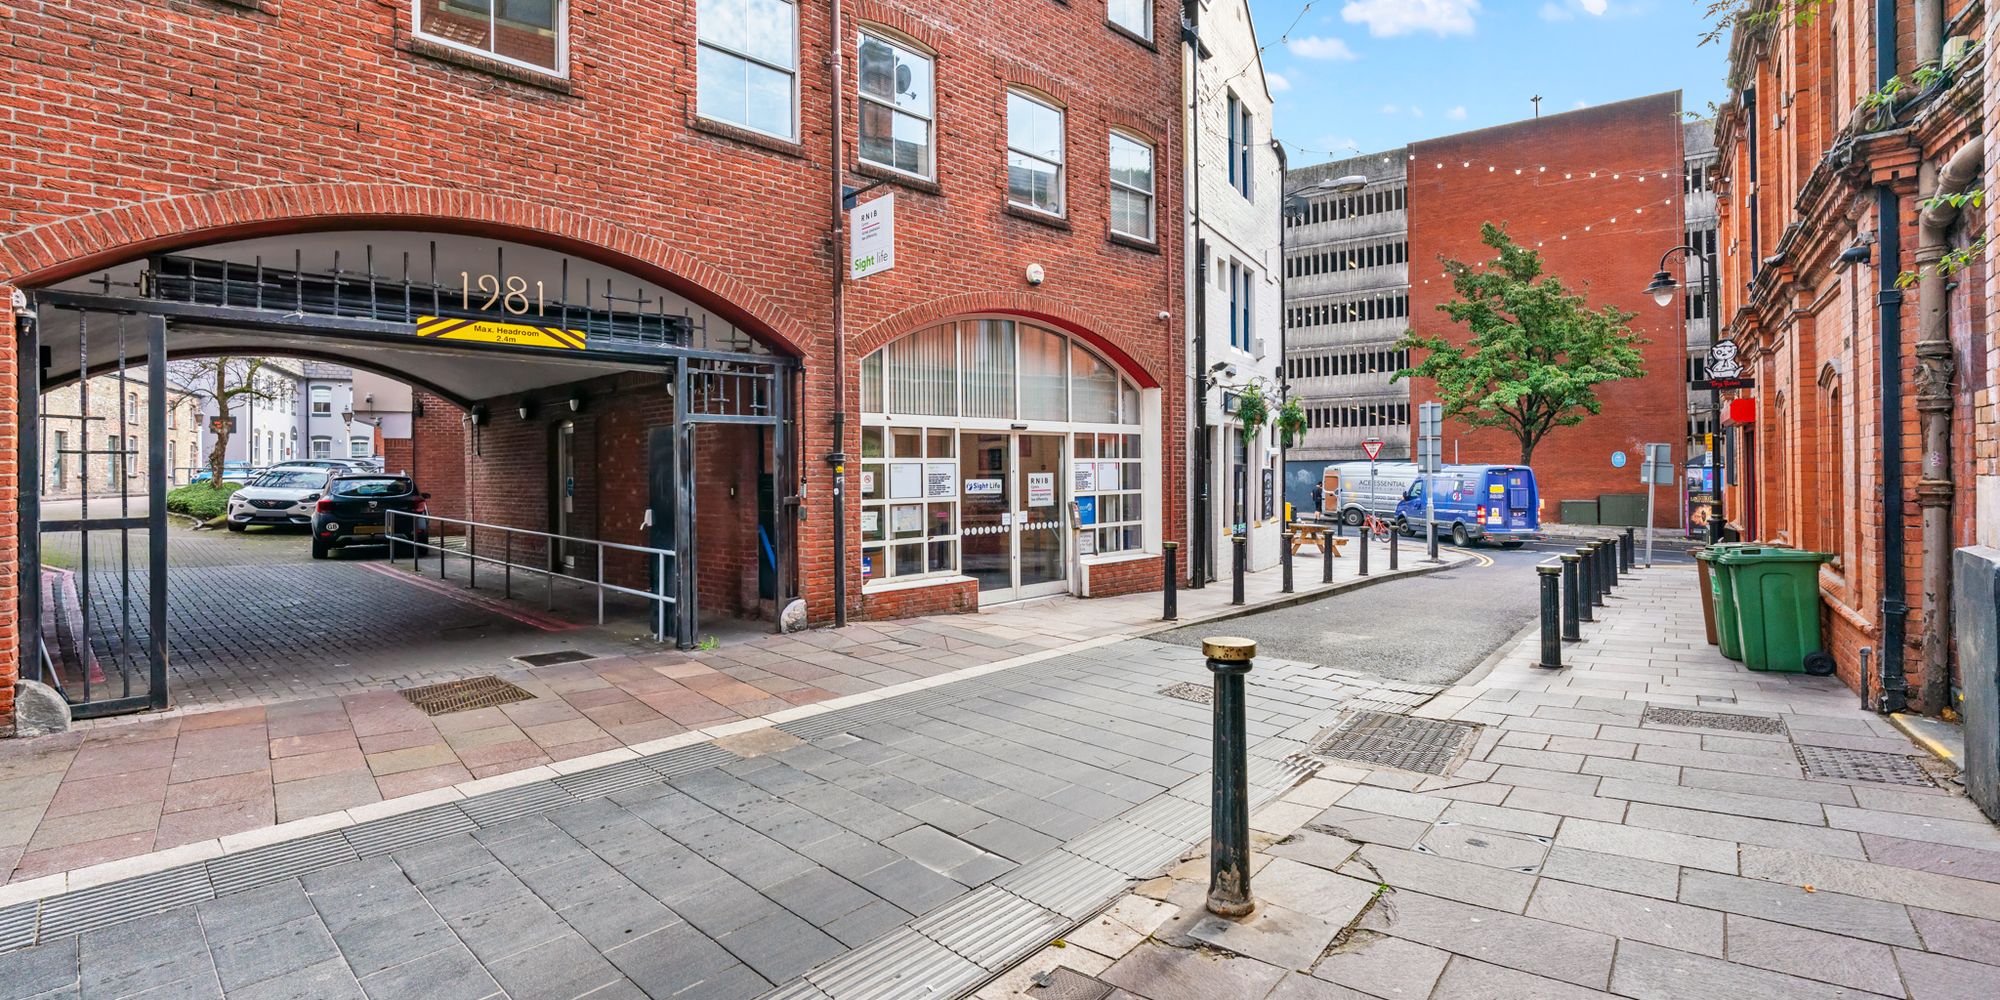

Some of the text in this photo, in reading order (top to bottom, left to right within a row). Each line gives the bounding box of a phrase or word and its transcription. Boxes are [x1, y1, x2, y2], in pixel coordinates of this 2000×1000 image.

[861, 210, 877, 221] RNIB
[854, 250, 888, 272] Sight life
[461, 271, 544, 317] 1981
[474, 325, 540, 337] Max. Headroom
[496, 335, 517, 343] 2.4m
[973, 482, 989, 491] Sight
[327, 523, 338, 531] GB
